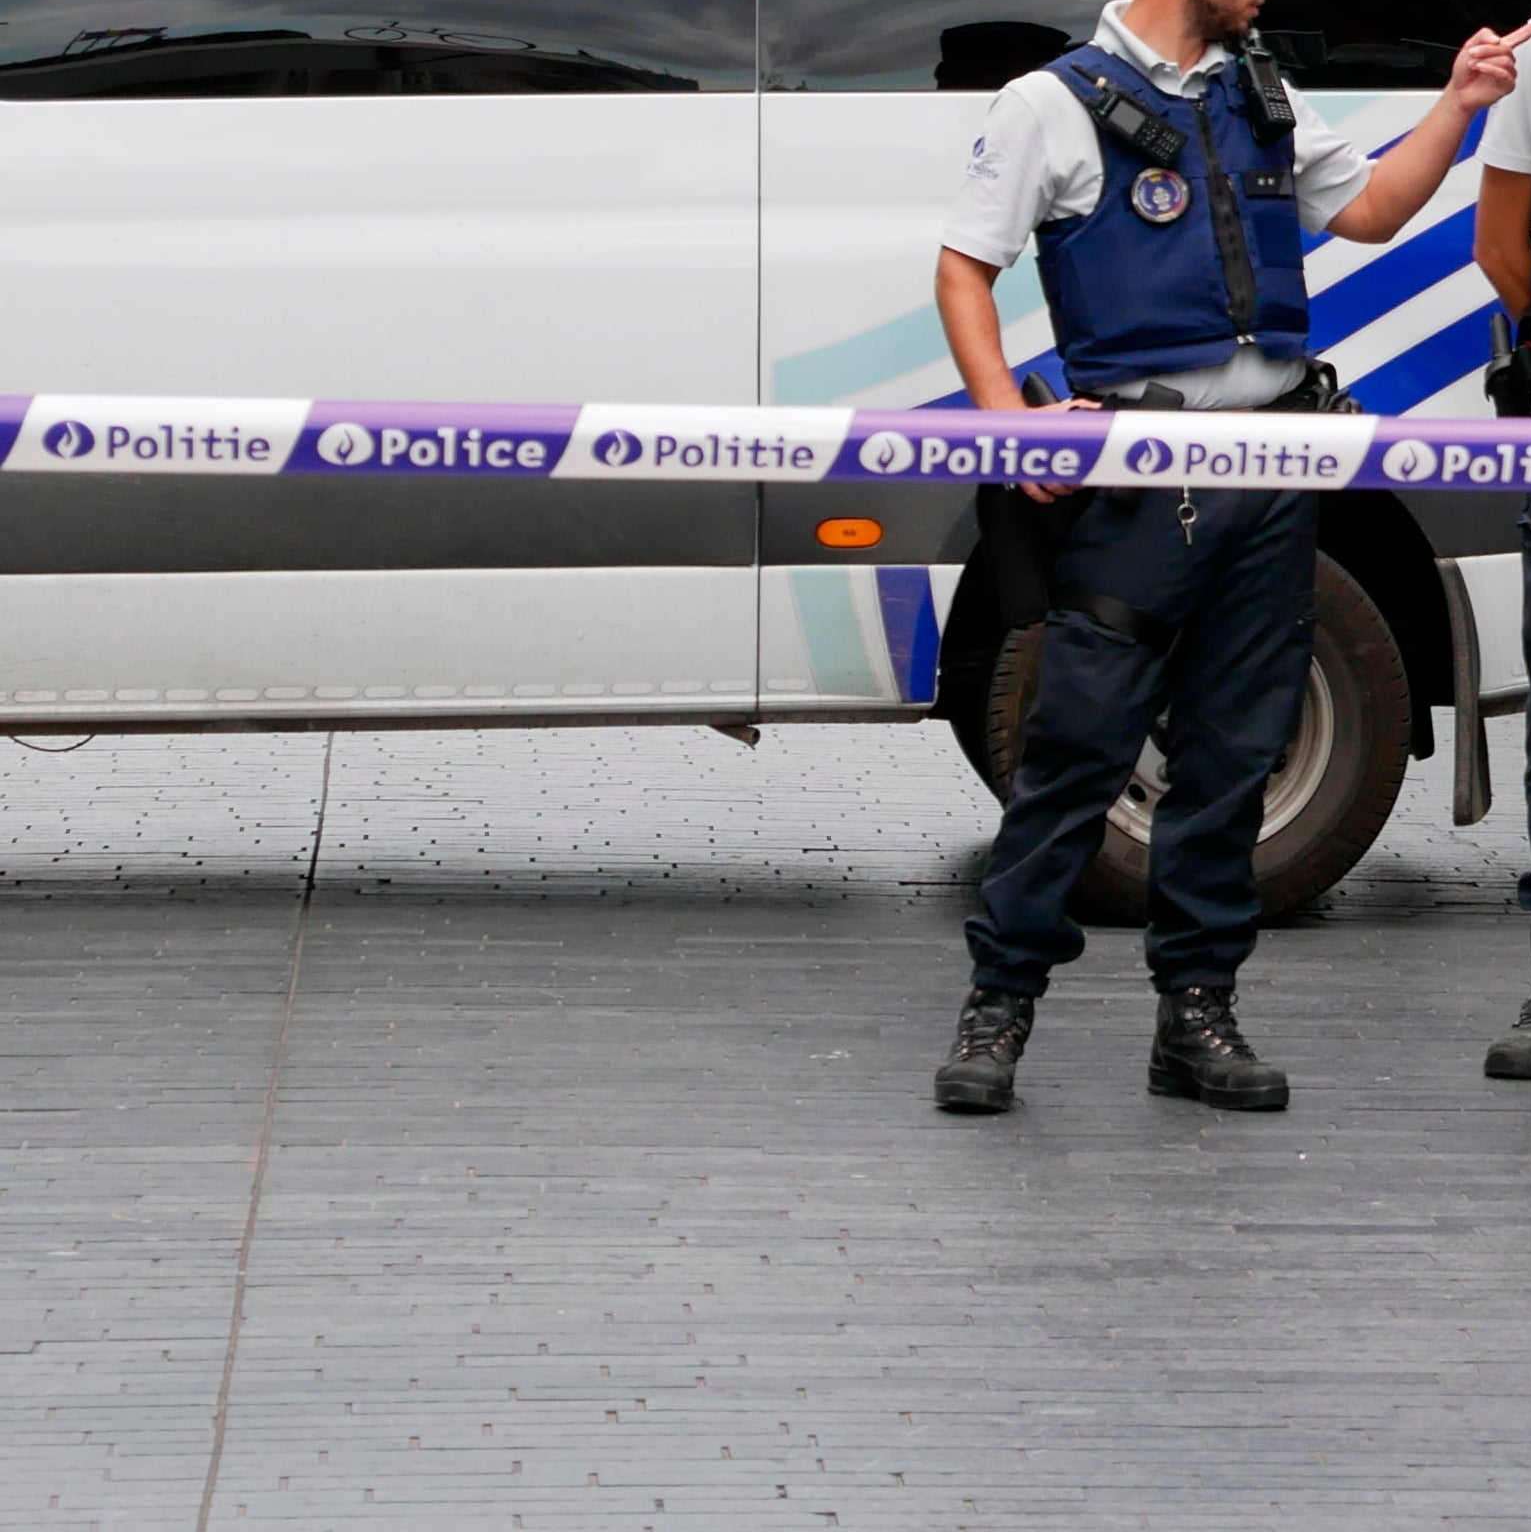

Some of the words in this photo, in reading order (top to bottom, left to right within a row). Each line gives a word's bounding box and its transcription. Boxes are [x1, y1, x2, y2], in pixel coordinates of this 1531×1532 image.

[106, 425, 271, 461] Politie
[380, 428, 547, 467] Police
[654, 432, 815, 468] Politie
[919, 434, 1081, 475] Police
[1186, 443, 1339, 478] Politie
